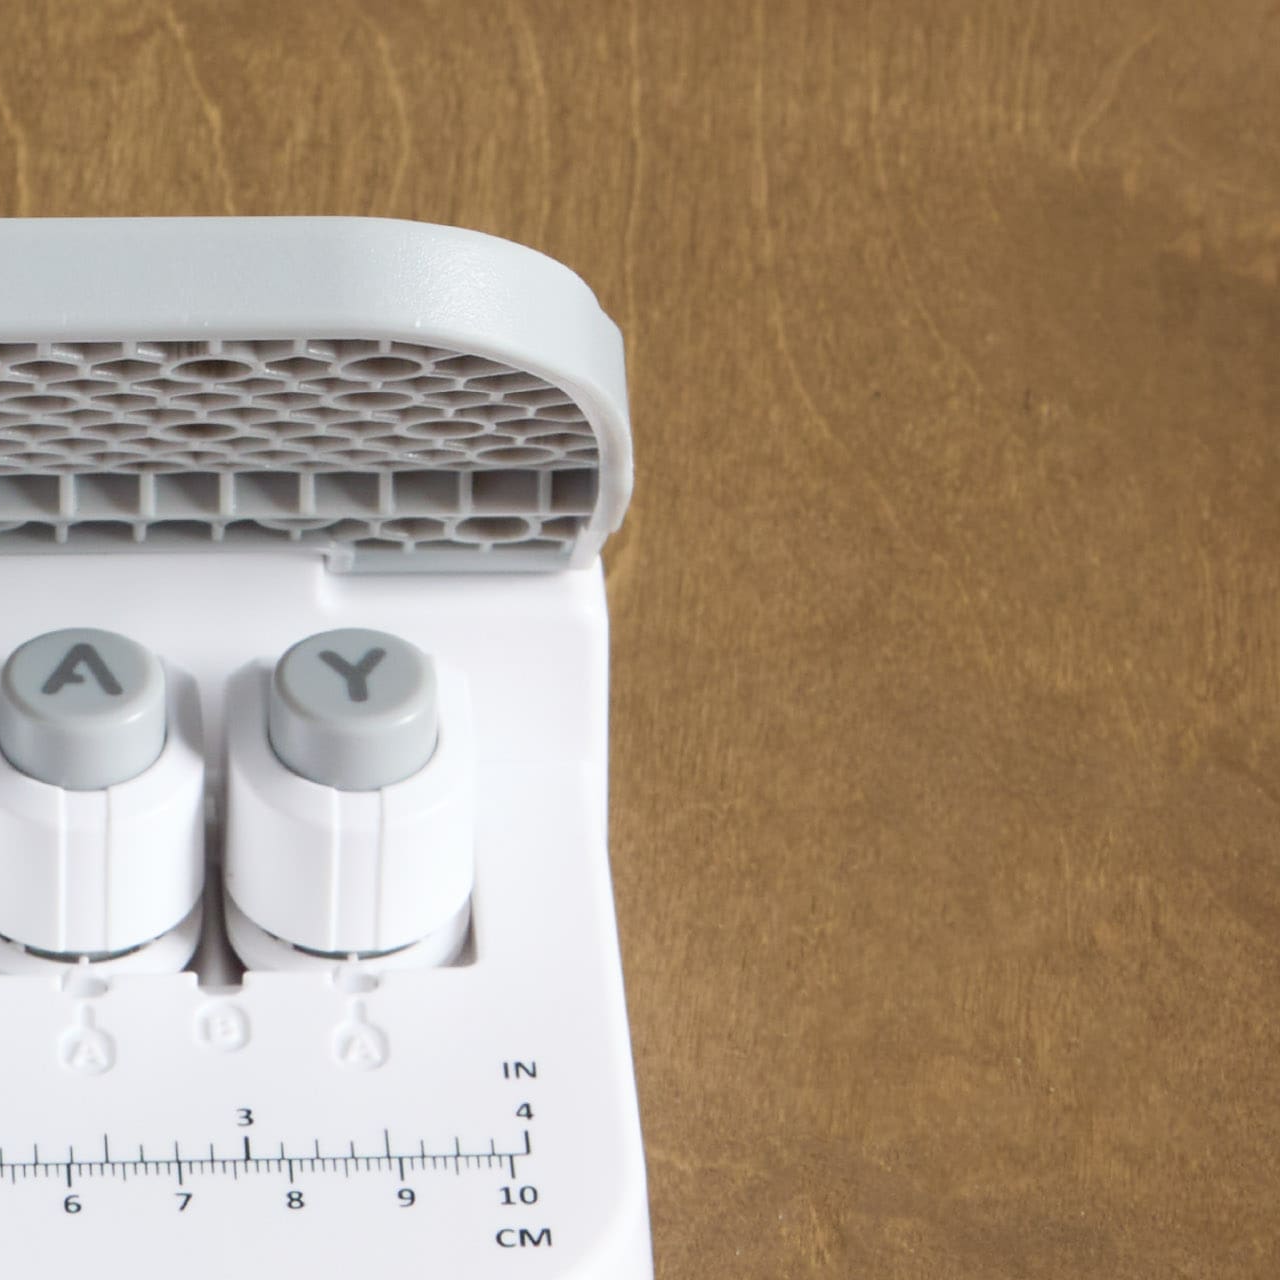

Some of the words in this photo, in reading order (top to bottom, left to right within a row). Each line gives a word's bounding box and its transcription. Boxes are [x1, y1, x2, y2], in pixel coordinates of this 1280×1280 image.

[42, 642, 123, 696] A
[318, 649, 387, 702] Y
[503, 1061, 537, 1079] IN
[239, 1108, 254, 1127] 3
[515, 1102, 534, 1121] 4
[63, 1194, 82, 1214] 6
[176, 1192, 193, 1212] 7
[286, 1190, 305, 1210] 8
[397, 1188, 416, 1207] 9
[500, 1185, 538, 1206] 10
[495, 1228, 552, 1248] CM
